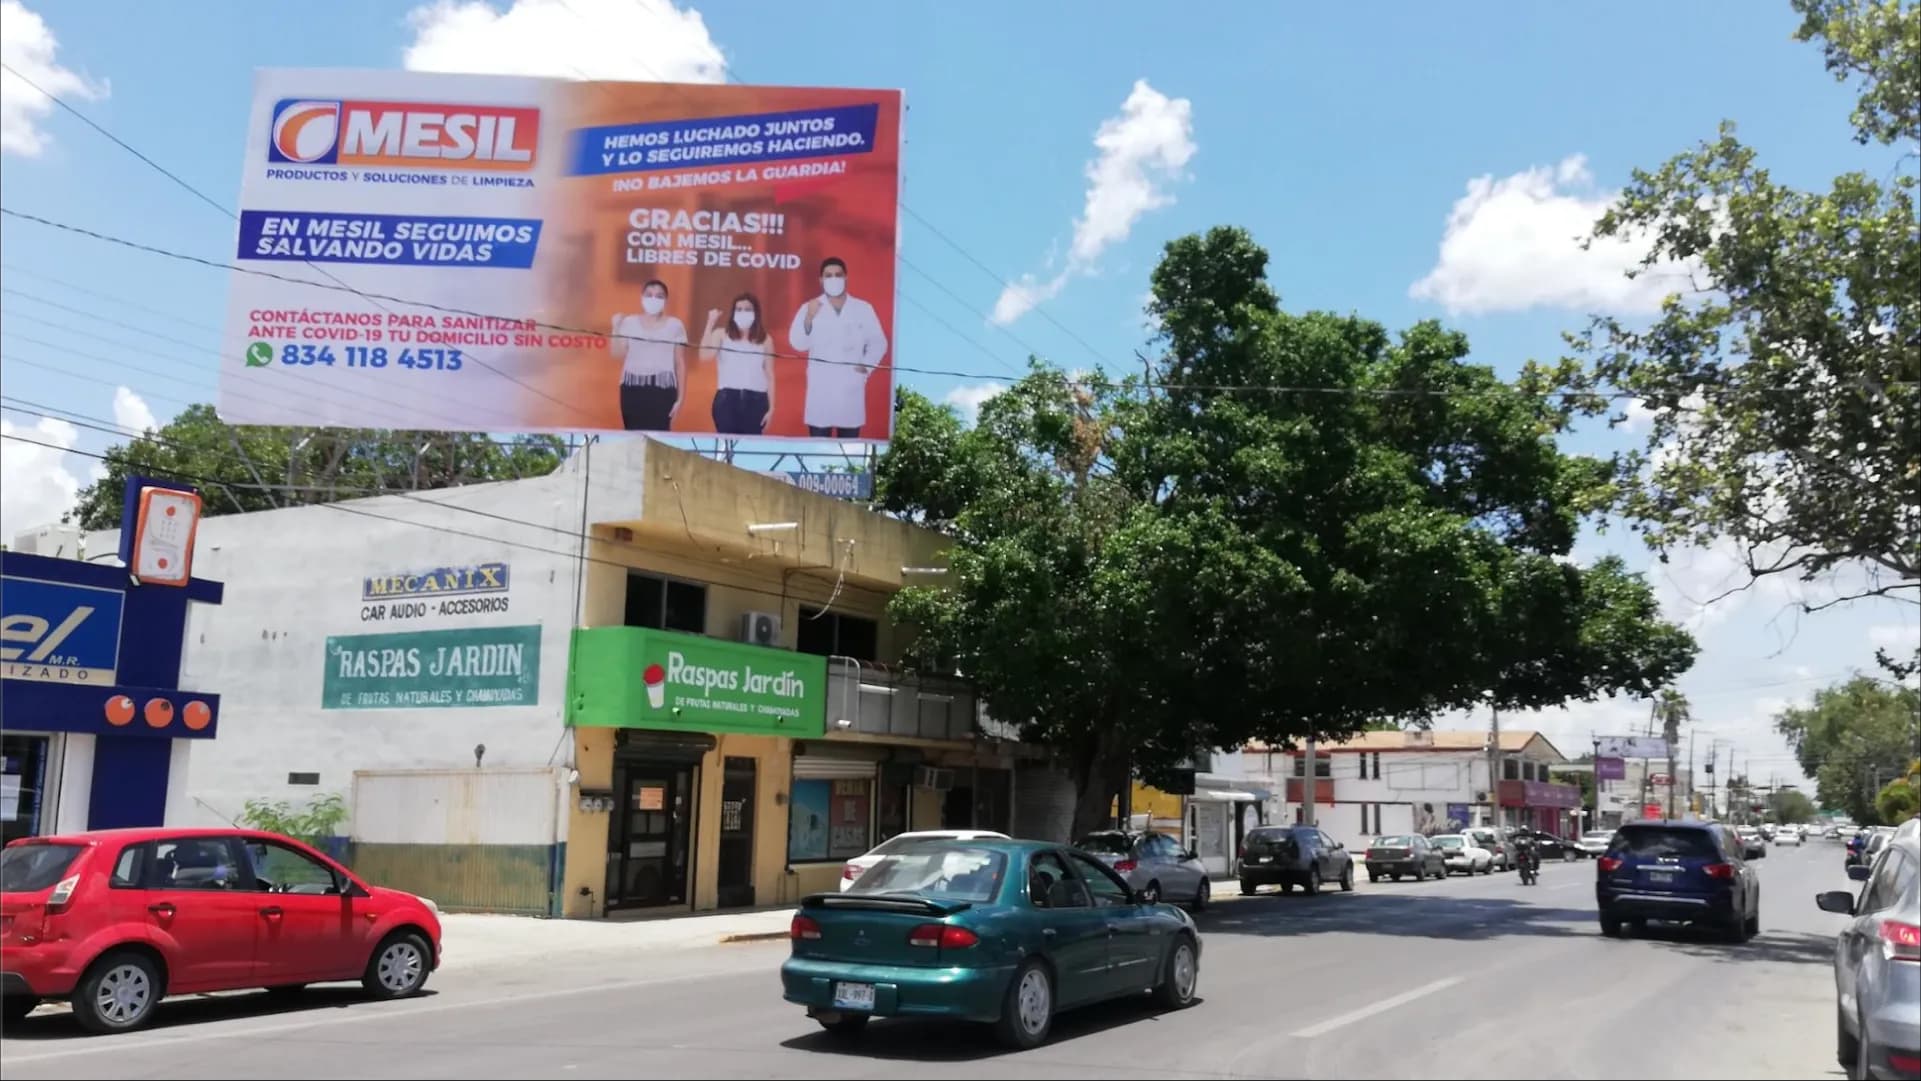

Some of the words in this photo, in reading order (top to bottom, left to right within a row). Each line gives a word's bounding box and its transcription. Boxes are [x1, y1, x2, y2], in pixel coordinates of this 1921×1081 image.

[343, 110, 532, 162] MESIL
[604, 131, 669, 150] HEMOS
[673, 123, 760, 145] LUCHADO
[764, 117, 836, 137] JUNTOS
[602, 153, 614, 167] Y
[619, 151, 642, 166] LO
[646, 141, 763, 164] SEGUIREMOS
[767, 131, 866, 154] HACIENDO.
[266, 168, 348, 182] PRODUCTOS
[350, 171, 359, 182] Y
[363, 172, 448, 185] SOLUCIONES
[451, 175, 469, 186] DE
[472, 176, 535, 188] LIMPIEZA
[648, 171, 731, 190] BAJEMOS
[735, 168, 758, 182] LA
[763, 160, 847, 181] GUARDIA!
[261, 217, 300, 236] EN
[307, 218, 385, 239] MESIL
[394, 222, 533, 243] SEGUIMOS
[628, 207, 784, 235] GRACIAS!!!
[255, 236, 403, 259] SALVANDO
[406, 242, 493, 261] VIDAS
[626, 231, 671, 248] CON
[677, 233, 752, 251] MESIL...
[626, 248, 698, 265] LIBRES
[703, 250, 732, 267] DE
[737, 252, 801, 270] COVID
[249, 307, 383, 328] CONTÁCTANOS
[388, 314, 436, 329] PARA
[442, 316, 537, 333] SANITIZAR
[248, 326, 296, 340] ANTE
[302, 328, 382, 342] COVID-19
[389, 330, 410, 343] TU
[416, 331, 508, 346] DOMICILIO
[514, 333, 541, 347] SIN
[548, 335, 608, 350] COSTO
[281, 344, 335, 366] 834
[344, 346, 388, 368] 118
[397, 348, 463, 371] 4513
[369, 567, 502, 595] MECANIX
[361, 606, 385, 621] CAR
[389, 603, 427, 619] AUDIO
[438, 597, 509, 616] ACCESORIOS
[48, 653, 81, 666] M.R.
[339, 648, 421, 678] RASPAS
[430, 643, 525, 677] JARDIN
[667, 651, 738, 697] Raspas
[742, 665, 805, 698] Jardín
[358, 691, 390, 705] FRUTAS
[395, 690, 452, 704] NATURALES
[455, 690, 464, 702] Y
[675, 696, 685, 707] DE
[686, 697, 710, 709] FRUTAS
